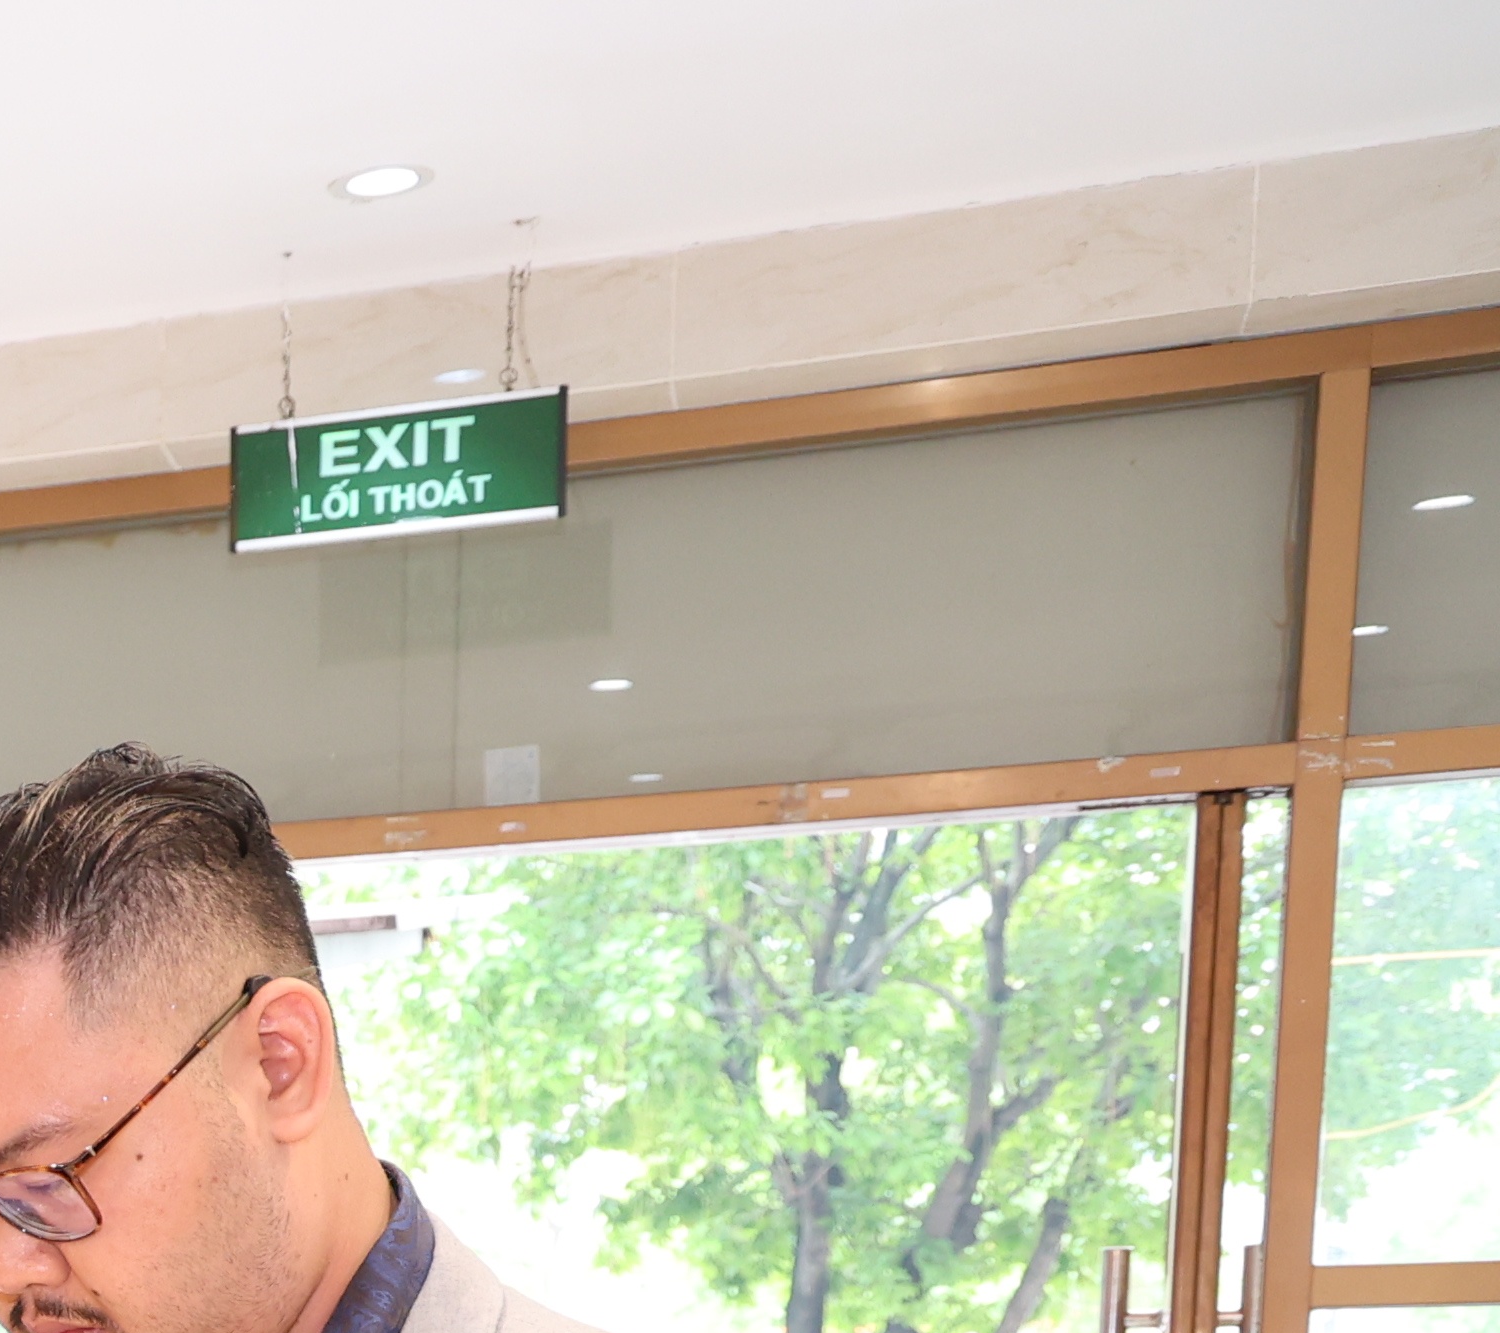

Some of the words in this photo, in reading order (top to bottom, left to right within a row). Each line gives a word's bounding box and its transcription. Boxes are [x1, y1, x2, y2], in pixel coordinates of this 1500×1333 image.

[319, 415, 476, 478] EXIT
[301, 479, 360, 523] LỐI
[367, 469, 492, 515] THOÁT
